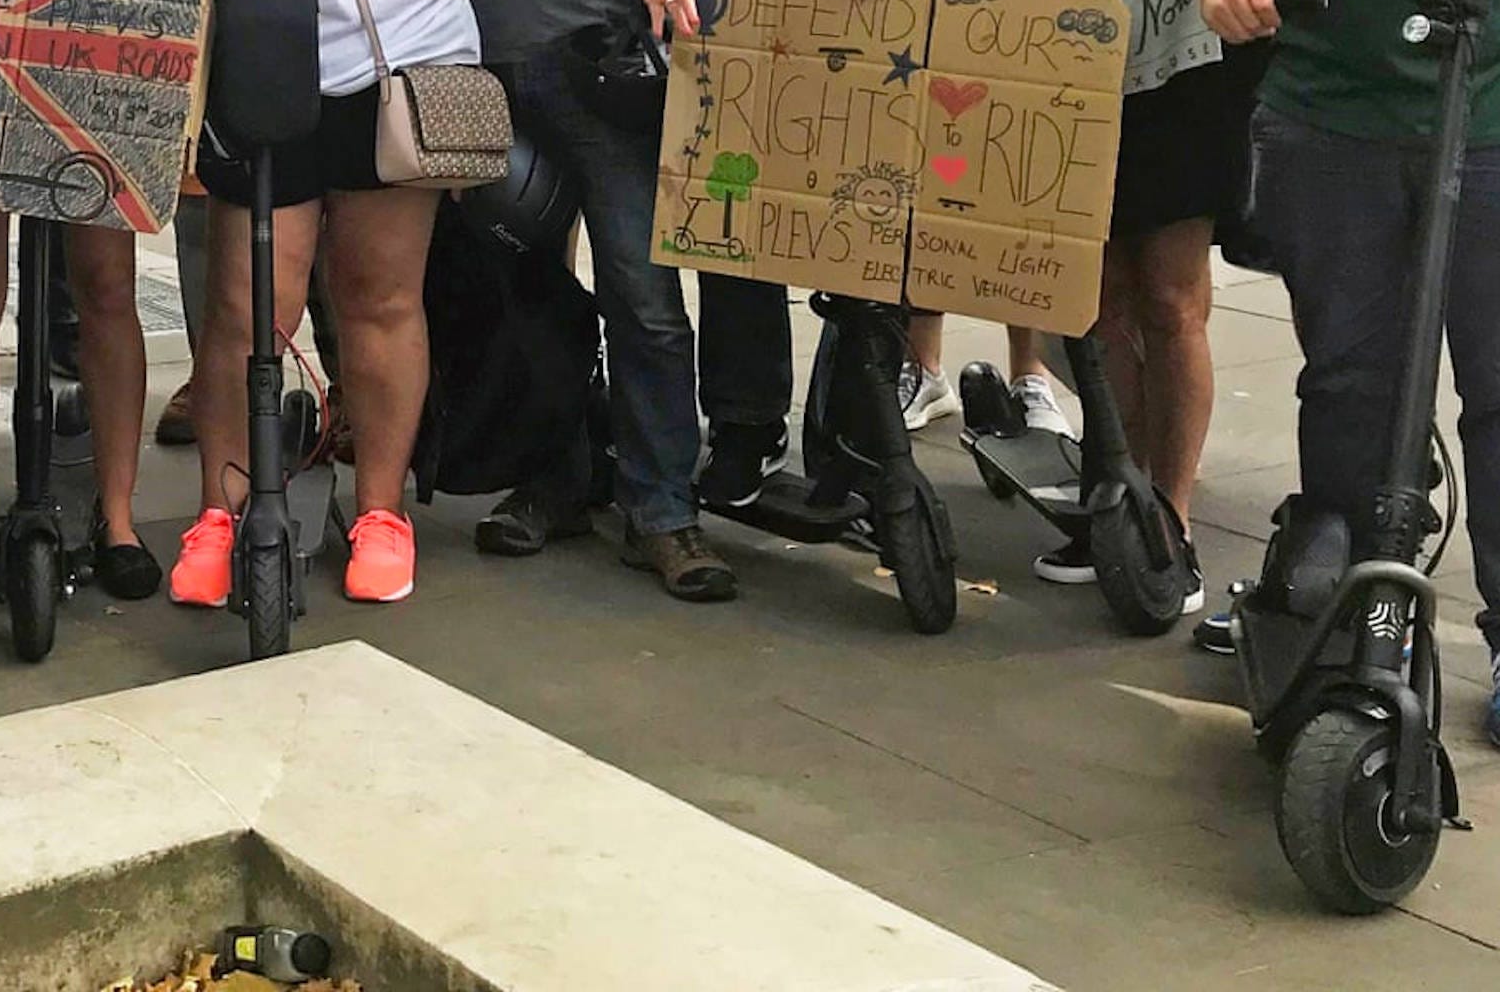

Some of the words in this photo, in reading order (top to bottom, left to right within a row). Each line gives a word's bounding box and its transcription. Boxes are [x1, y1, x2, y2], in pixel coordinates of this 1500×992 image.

[966, 6, 1059, 71] OUR
[50, 39, 97, 74] UK
[117, 41, 195, 84] ROADS
[715, 56, 927, 177] RIGHTS
[942, 122, 962, 147] To
[979, 101, 1112, 217] RIDE
[999, 248, 1066, 280] LIGHT
[972, 274, 1053, 311] VEHICLES
